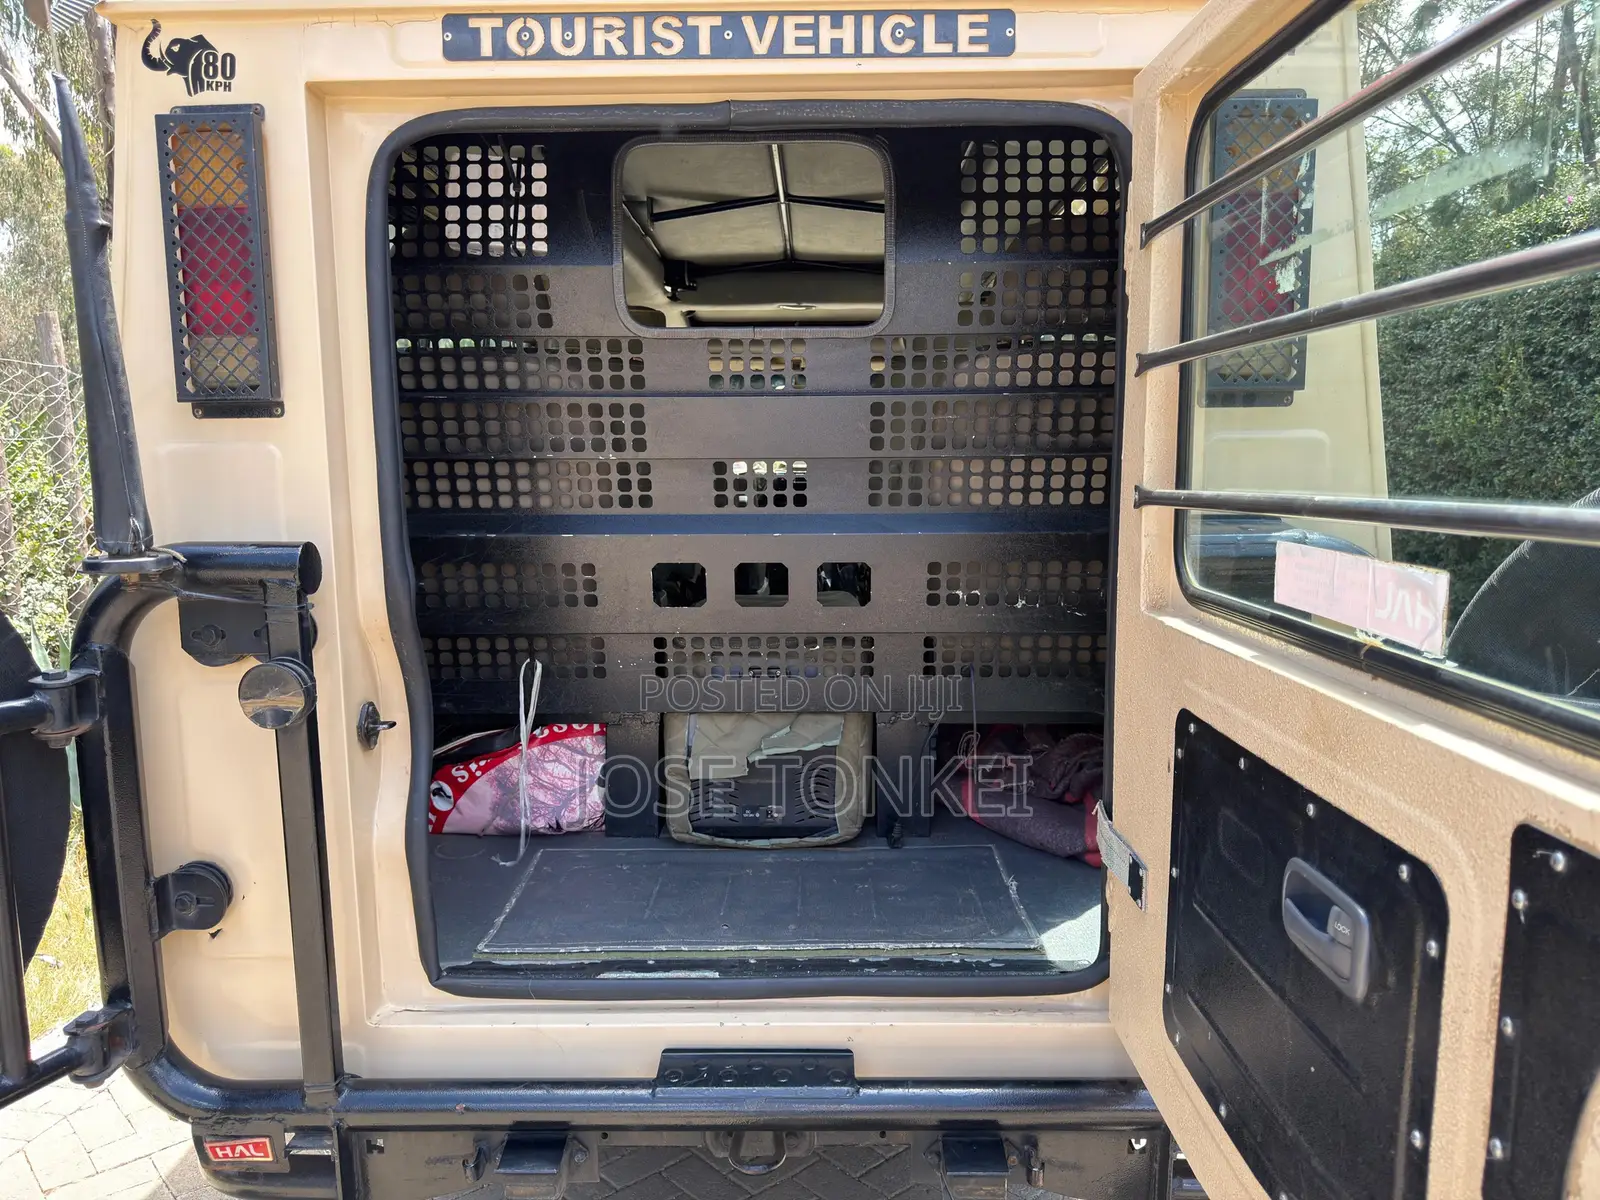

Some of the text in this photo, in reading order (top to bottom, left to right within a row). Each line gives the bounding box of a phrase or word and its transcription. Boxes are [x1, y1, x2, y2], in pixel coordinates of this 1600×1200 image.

[468, 14, 989, 57] TOURIST VEHICLE
[203, 52, 236, 80] 80
[206, 80, 232, 92] KPH
[1334, 921, 1351, 935] LOCK
[215, 1144, 265, 1158] HAL
